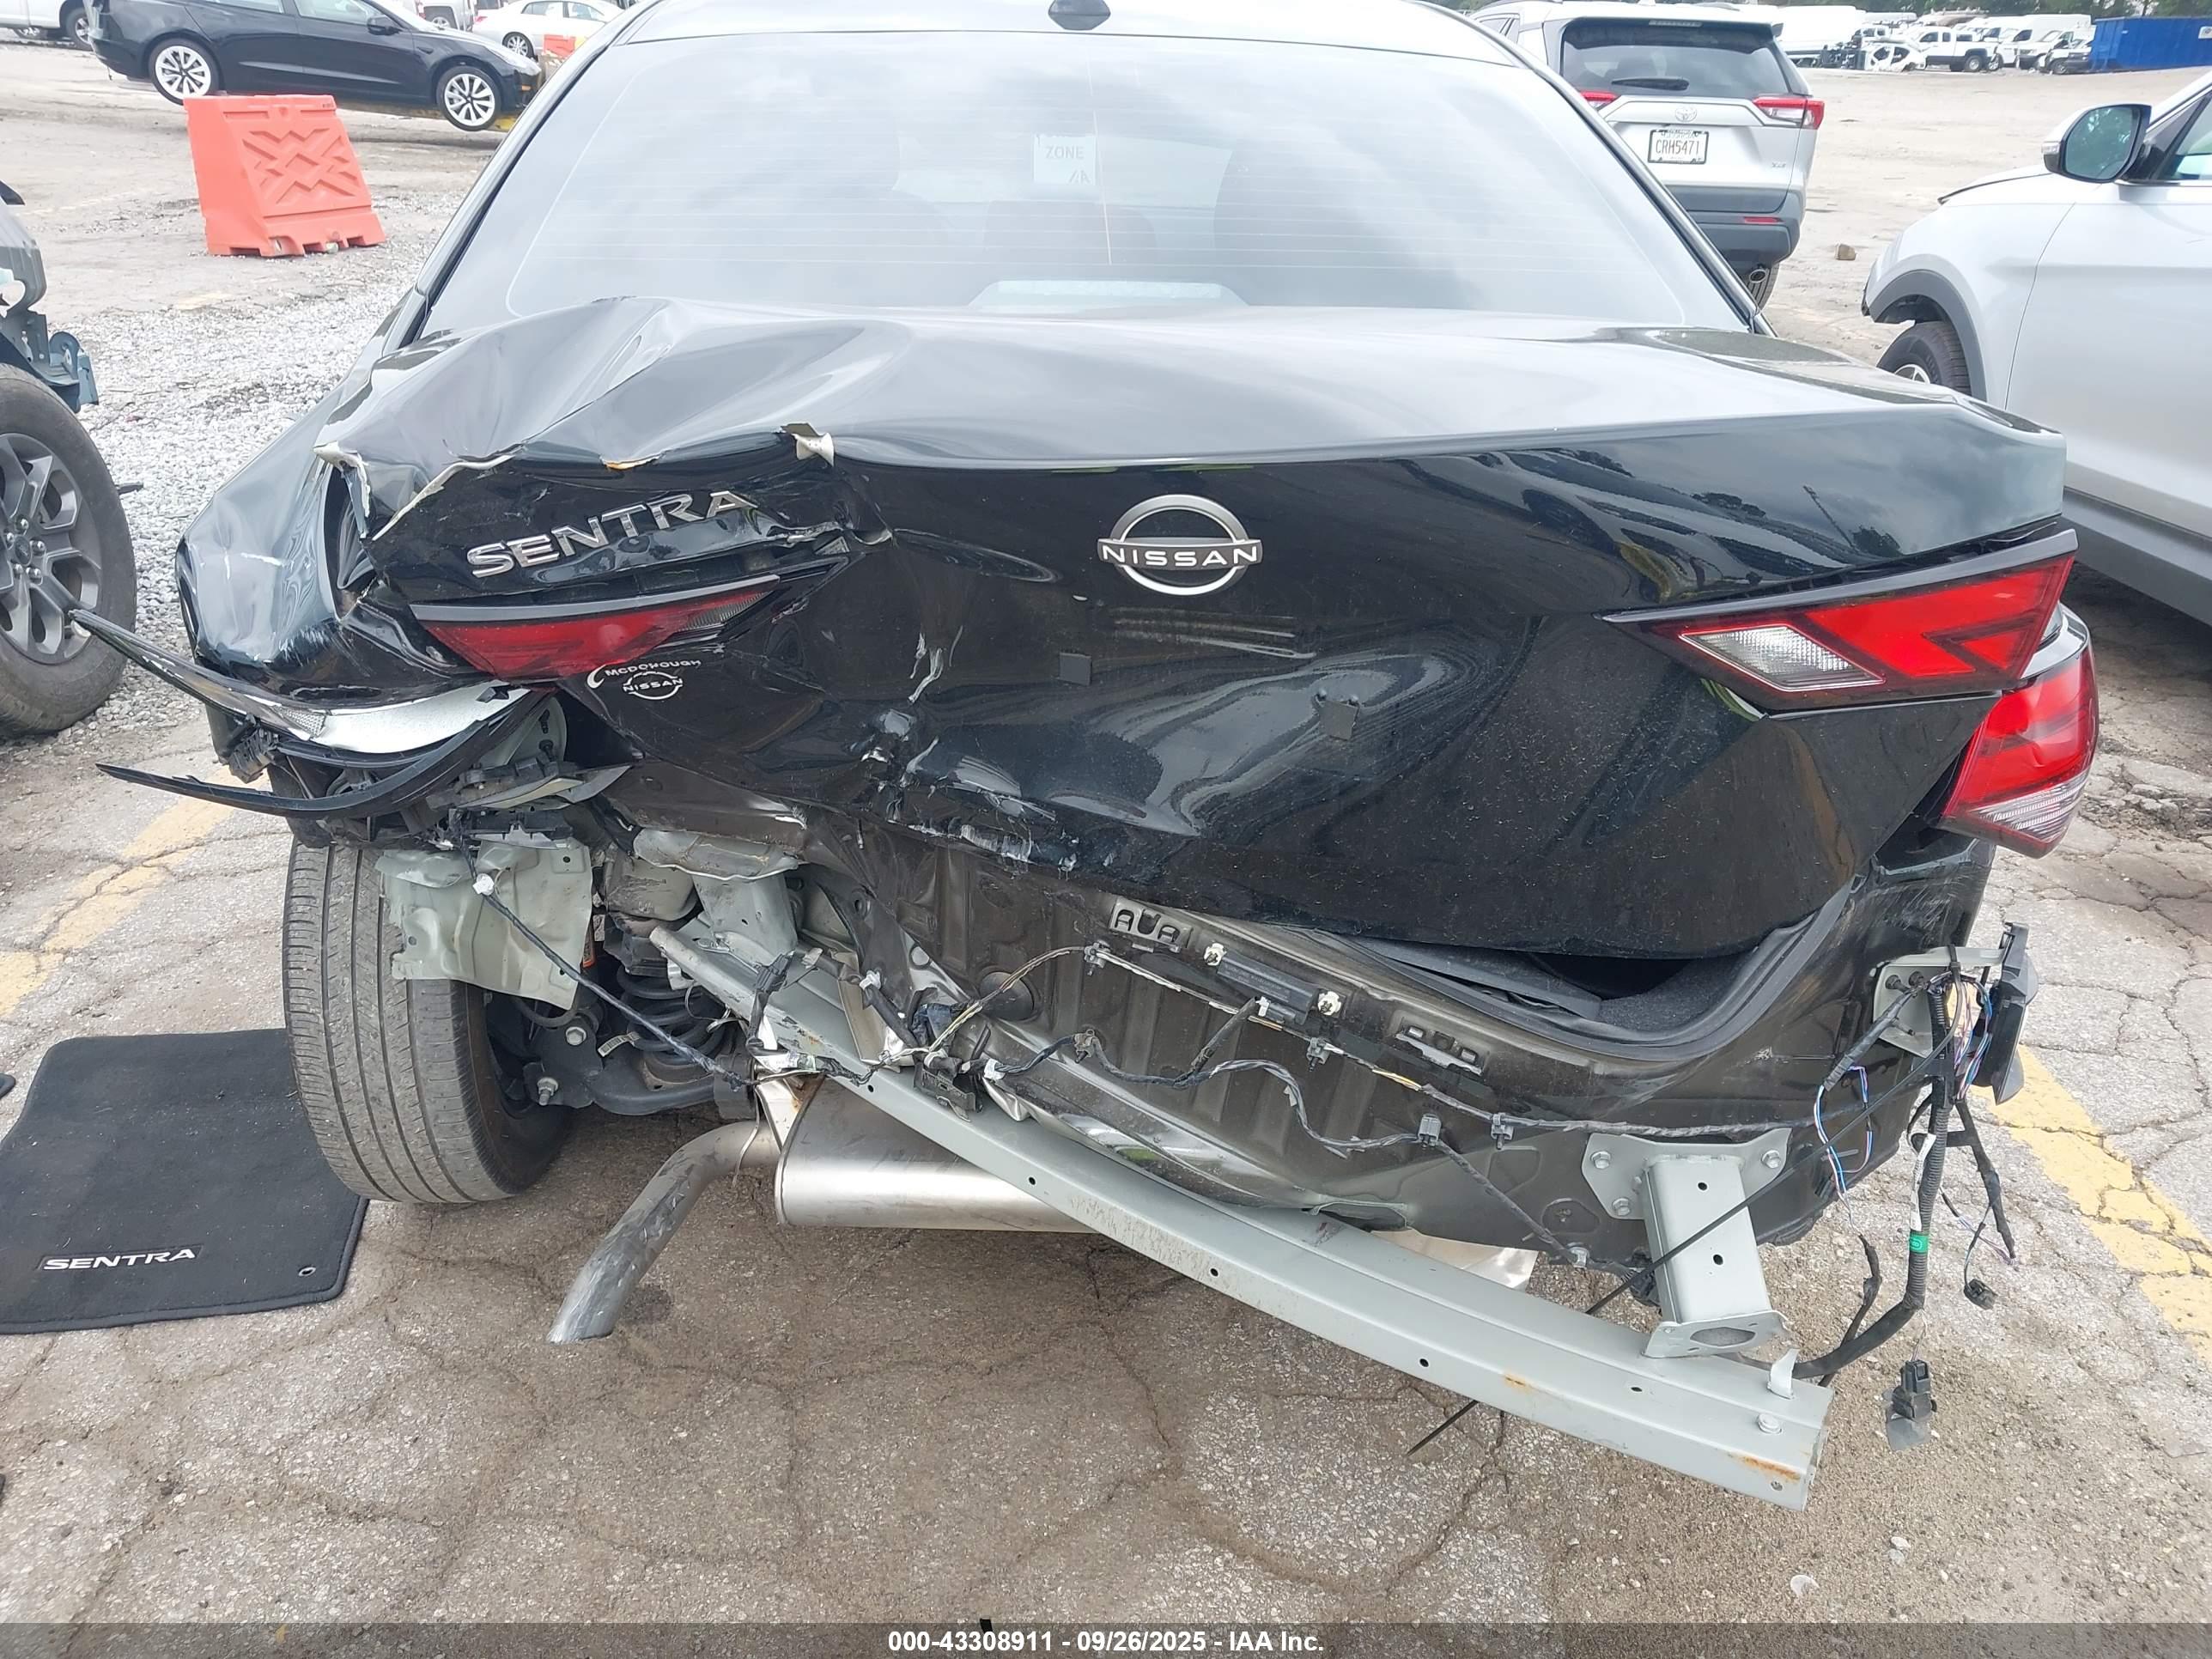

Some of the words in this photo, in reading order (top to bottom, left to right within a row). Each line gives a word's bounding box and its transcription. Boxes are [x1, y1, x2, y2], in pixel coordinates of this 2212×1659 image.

[1045, 145, 1085, 159] ZONE
[1656, 139, 1699, 155] CRH5471
[467, 490, 758, 578] SENTRA
[1102, 545, 1257, 567] NISSAN
[623, 678, 684, 692] NISSAN
[44, 1249, 196, 1270] SENTRA
